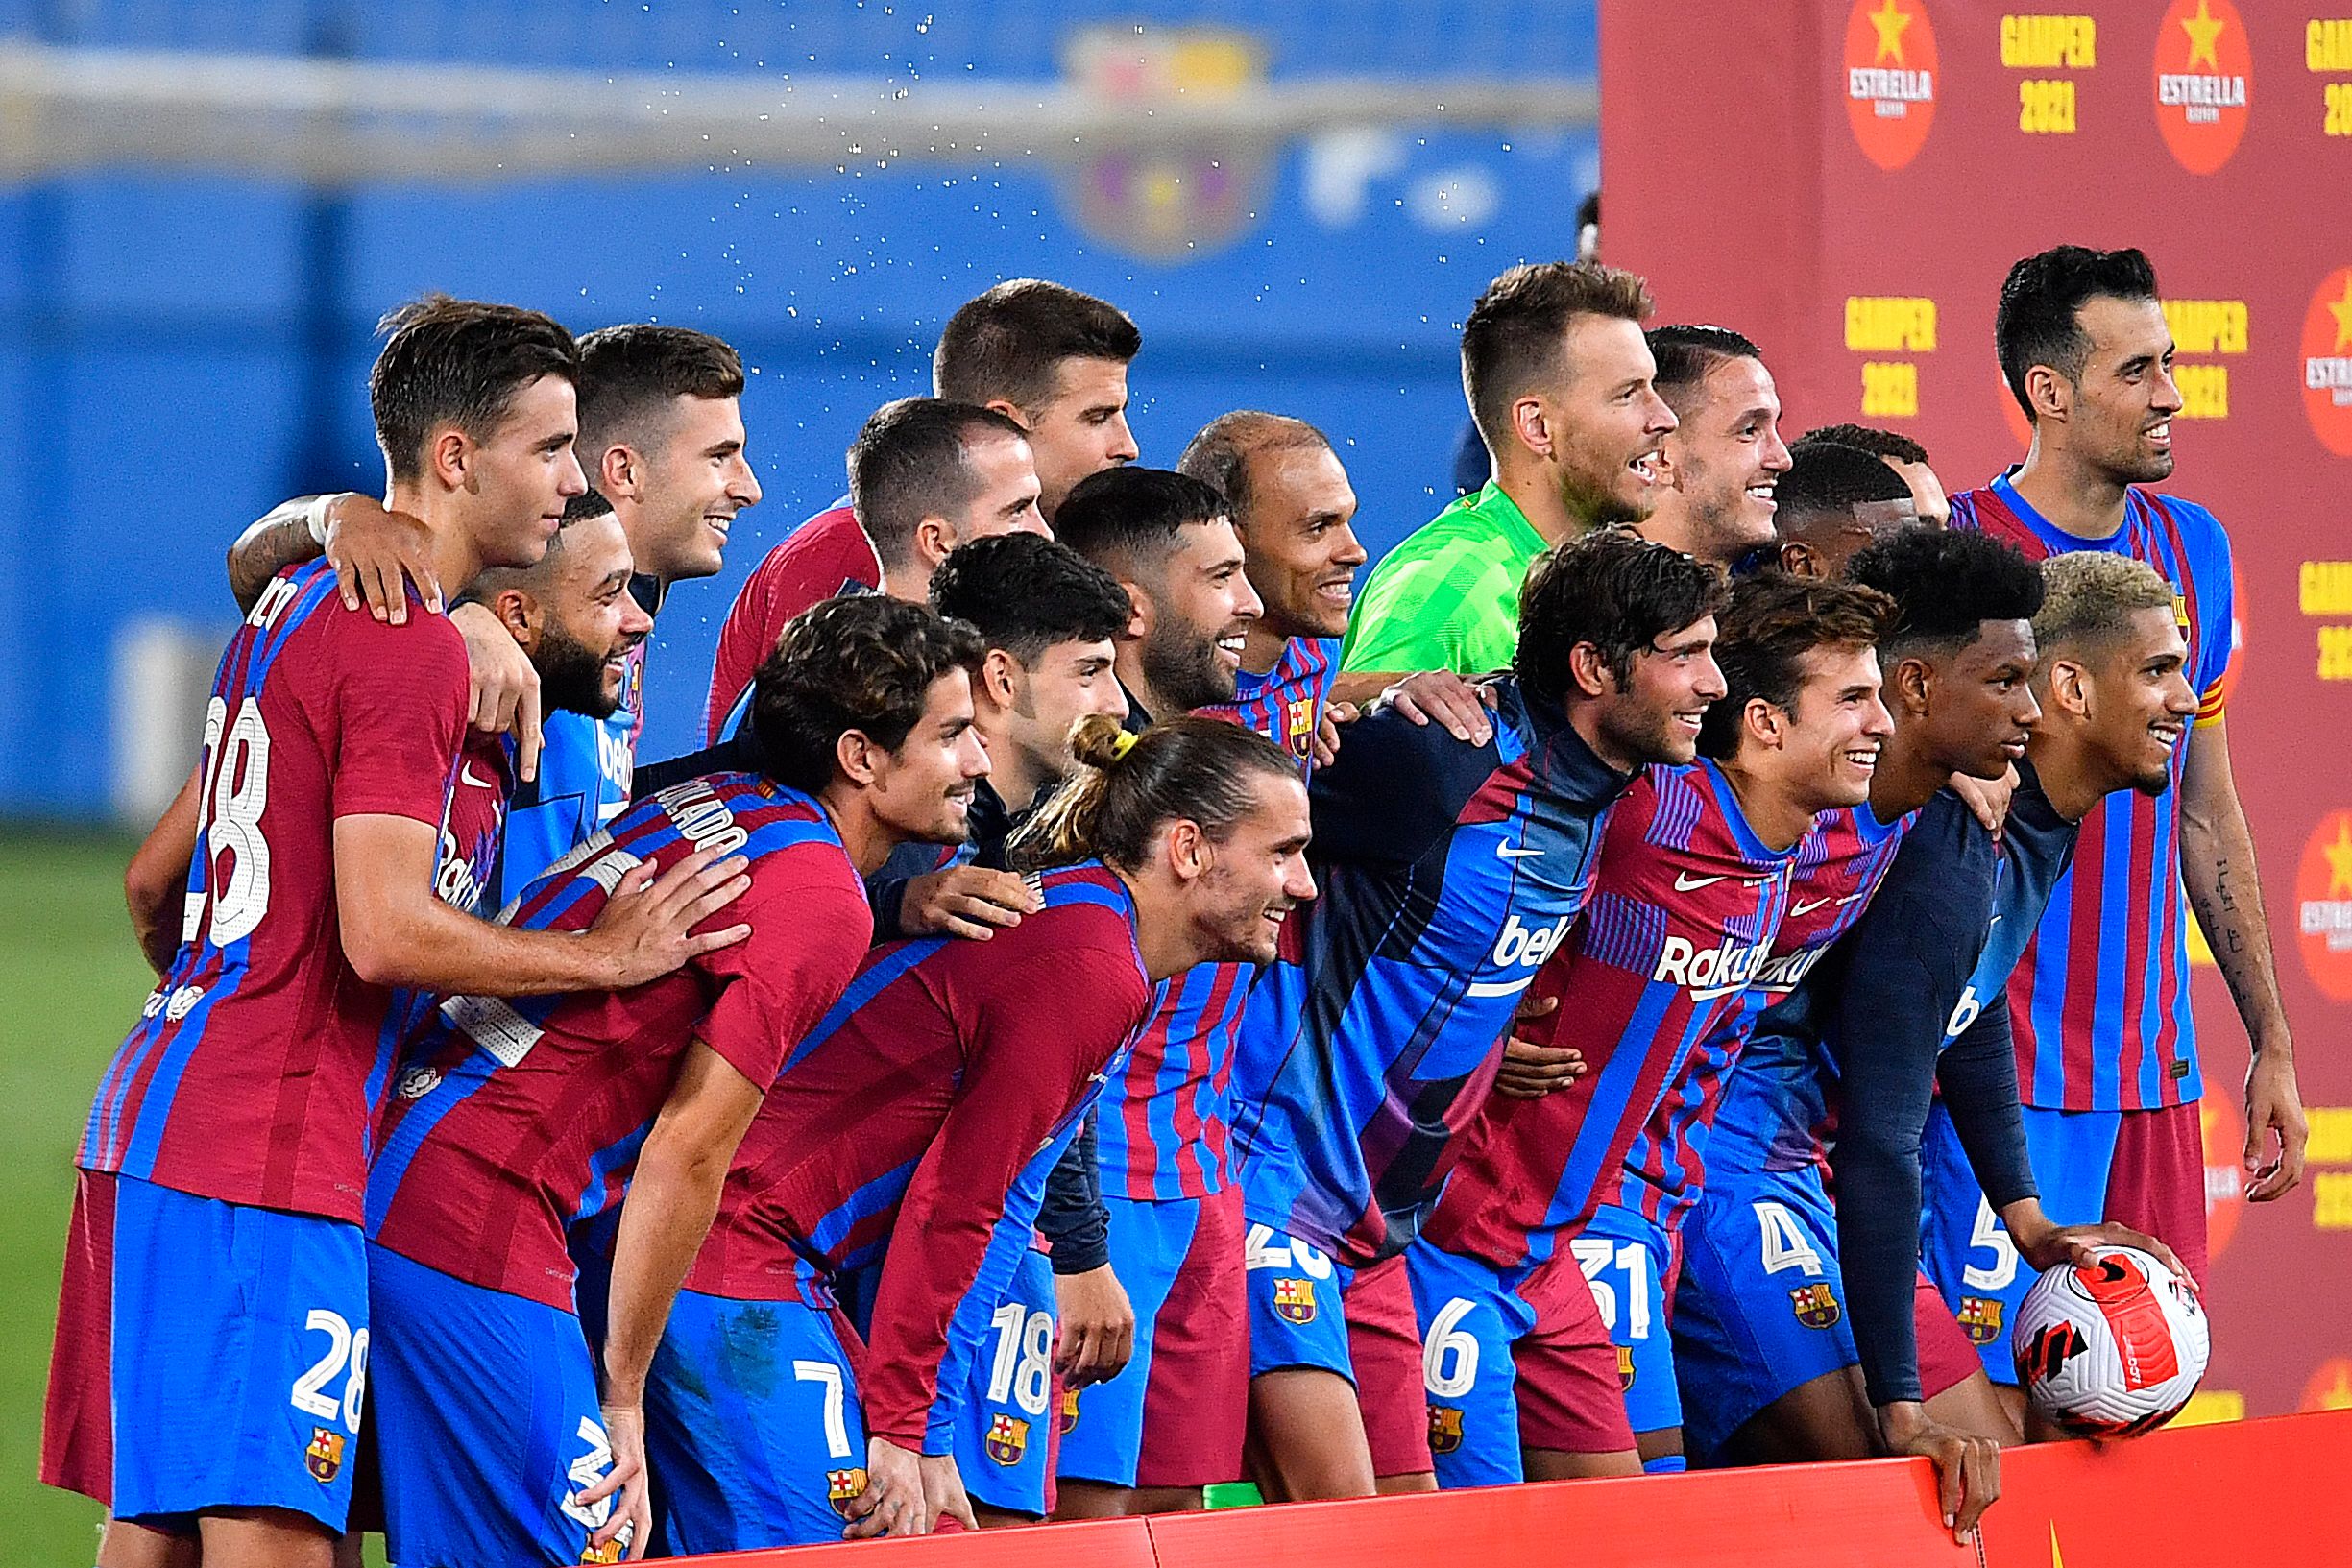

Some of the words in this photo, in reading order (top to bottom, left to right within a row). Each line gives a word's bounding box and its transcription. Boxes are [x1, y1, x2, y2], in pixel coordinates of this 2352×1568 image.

[1849, 67, 1933, 100] ESTRELLA
[2000, 14, 2096, 68] GAMPER
[2020, 80, 2076, 133] 2021
[2159, 74, 2246, 107] ESTRELLA
[1754, 1202, 1824, 1277] 4
[1963, 1192, 2020, 1291] 5
[1570, 1239, 1650, 1339] 31
[290, 1309, 370, 1435] 28
[986, 1303, 1055, 1415] 18
[1422, 1297, 1478, 1398] 6
[793, 1361, 853, 1459] 7
